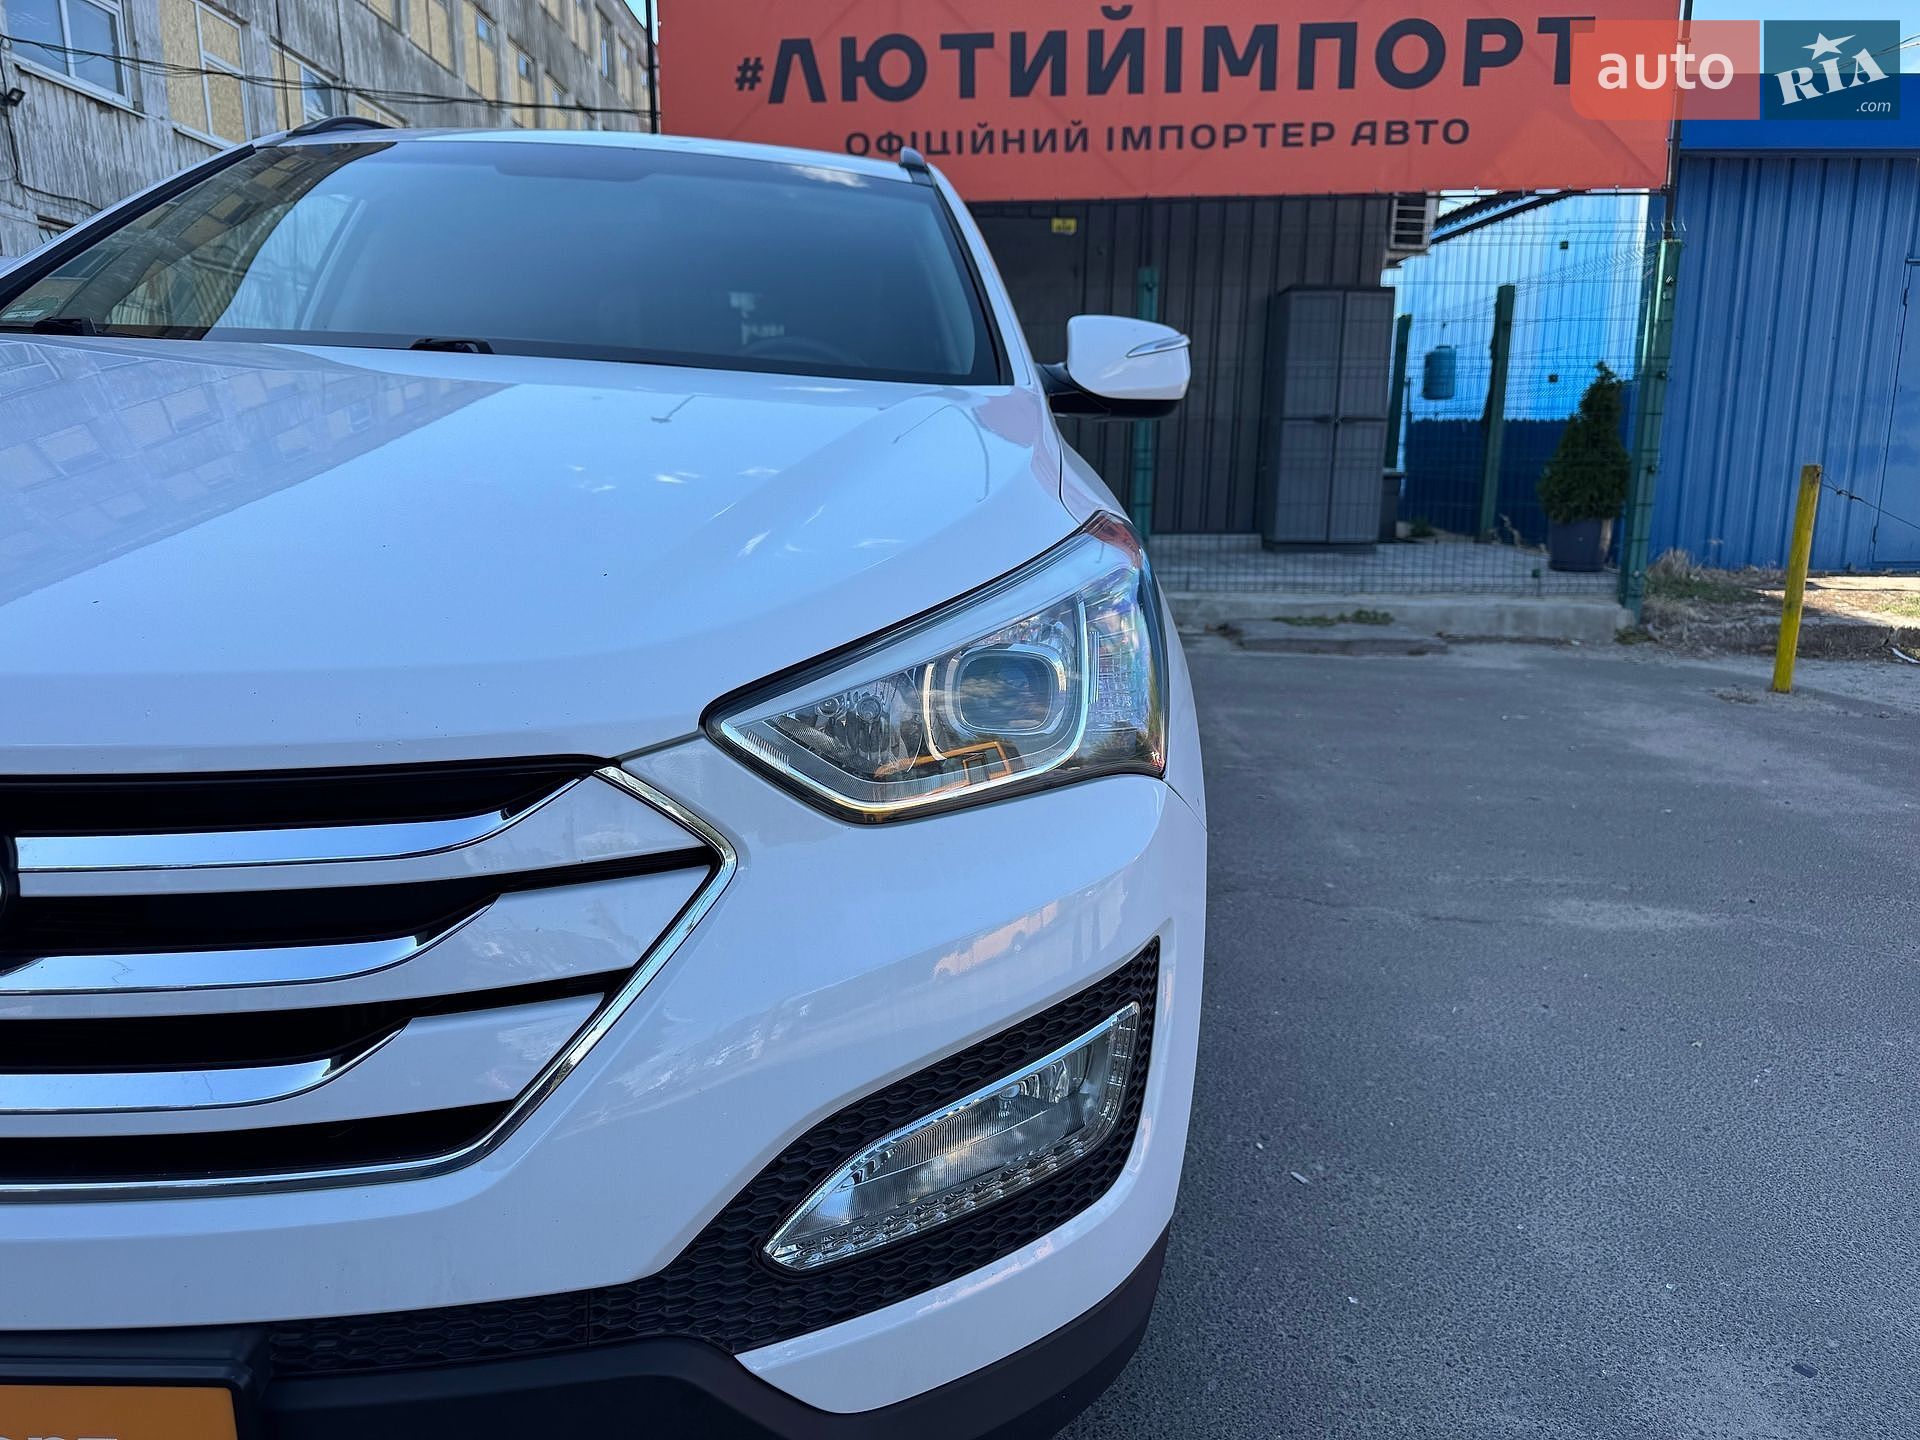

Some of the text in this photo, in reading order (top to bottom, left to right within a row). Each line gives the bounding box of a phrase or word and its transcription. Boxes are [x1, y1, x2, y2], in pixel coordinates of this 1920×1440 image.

[735, 4, 1597, 104] #ЛЮТИЙІМПОРТ
[845, 118, 1470, 157] ОФІЦІЙНИЙ ІМПОРТЕР АВТО
